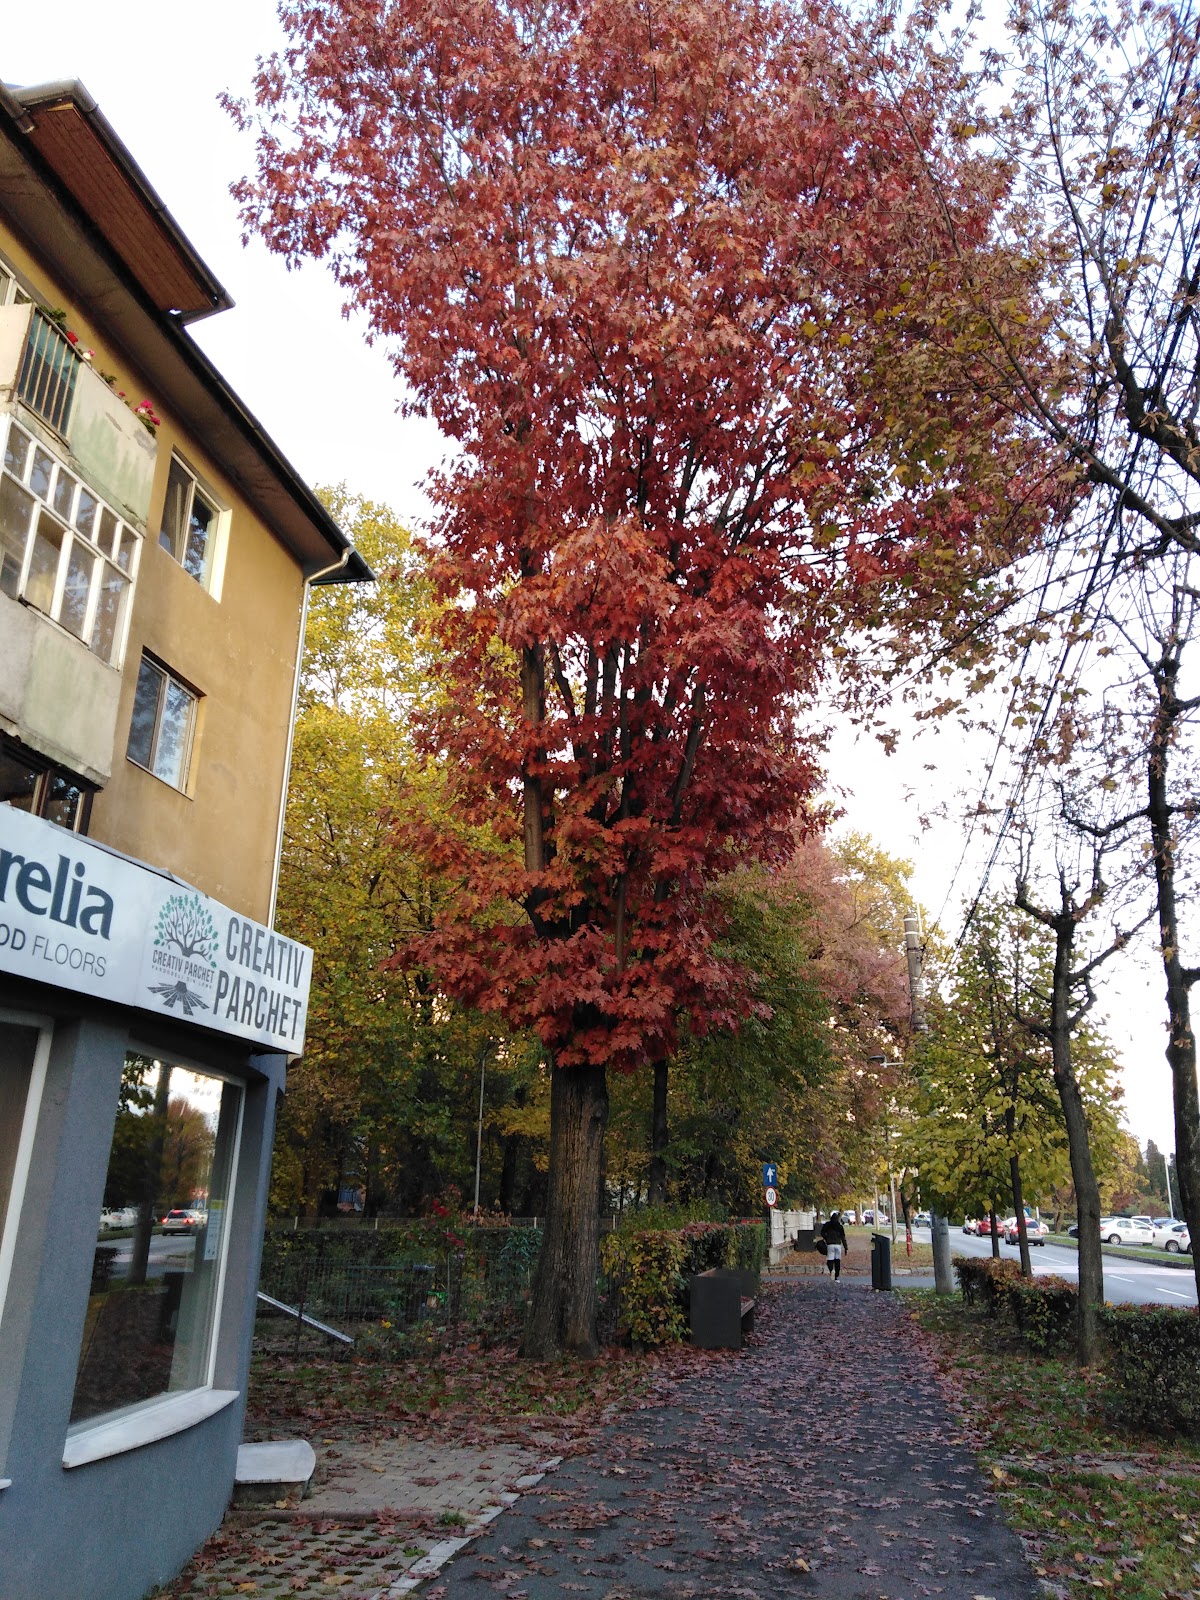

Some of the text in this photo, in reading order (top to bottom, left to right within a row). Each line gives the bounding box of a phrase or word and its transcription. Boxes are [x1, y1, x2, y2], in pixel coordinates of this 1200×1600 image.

[32, 935, 107, 977] FLOORS
[153, 949, 214, 984] CREATIV PARCHET
[226, 916, 304, 989] CREATIV
[213, 970, 302, 1040] PARCHET
[768, 1192, 774, 1201] 30
